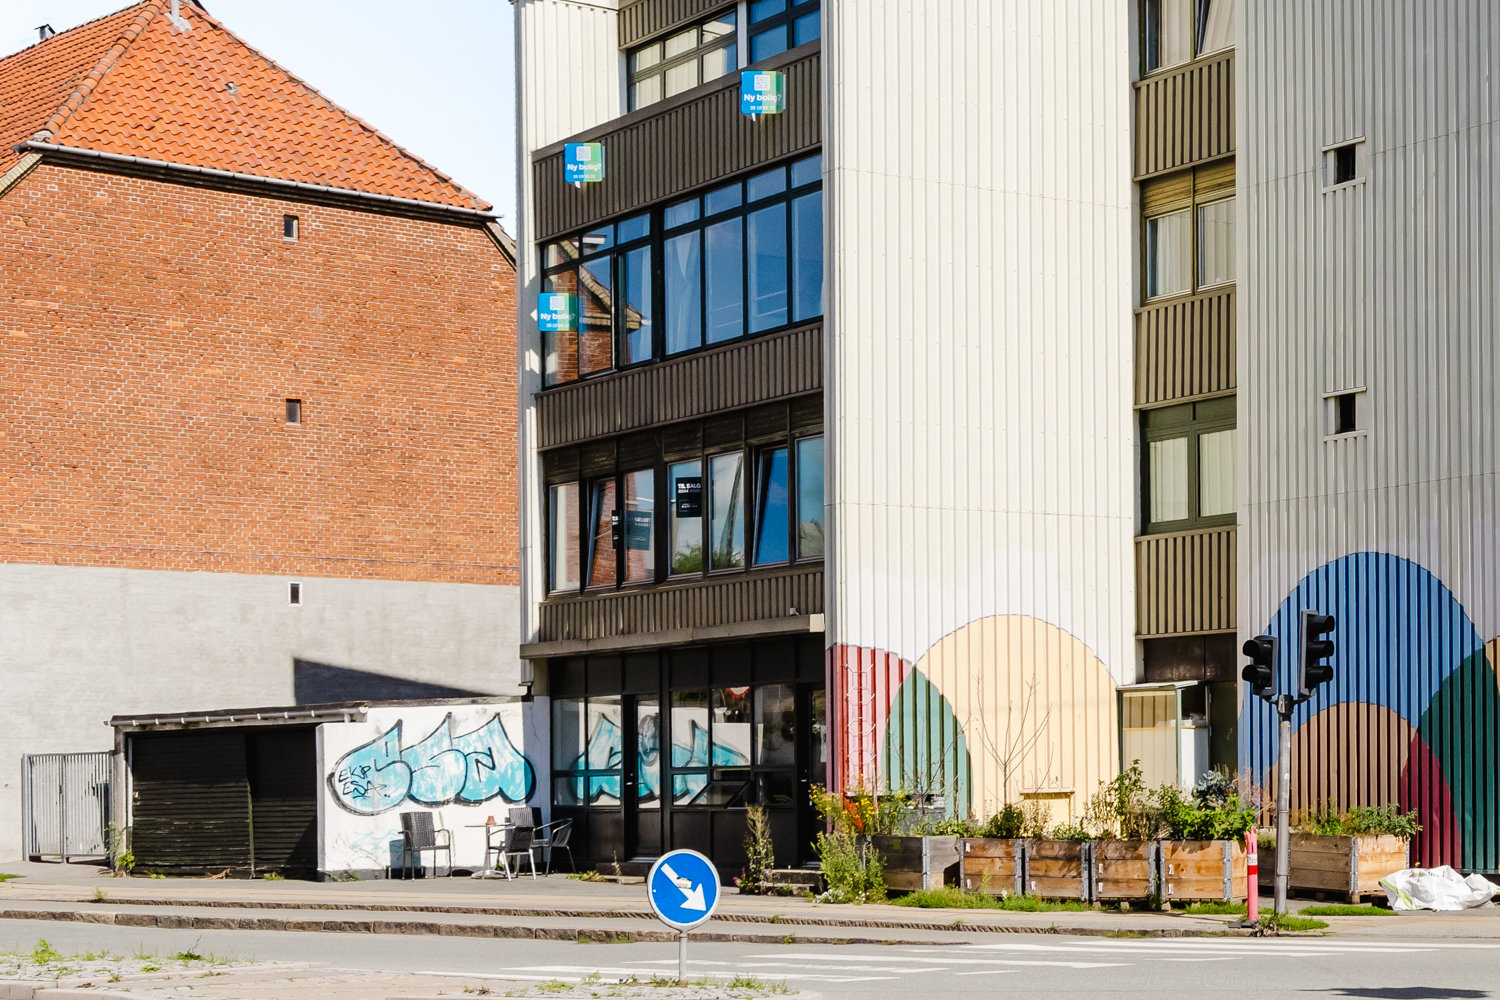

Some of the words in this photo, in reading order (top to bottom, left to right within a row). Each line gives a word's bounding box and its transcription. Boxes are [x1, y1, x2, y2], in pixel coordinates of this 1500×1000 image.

[744, 94, 755, 102] Ny
[756, 94, 782, 103] bolig?
[567, 163, 578, 171] Ny
[540, 312, 551, 321] Ny
